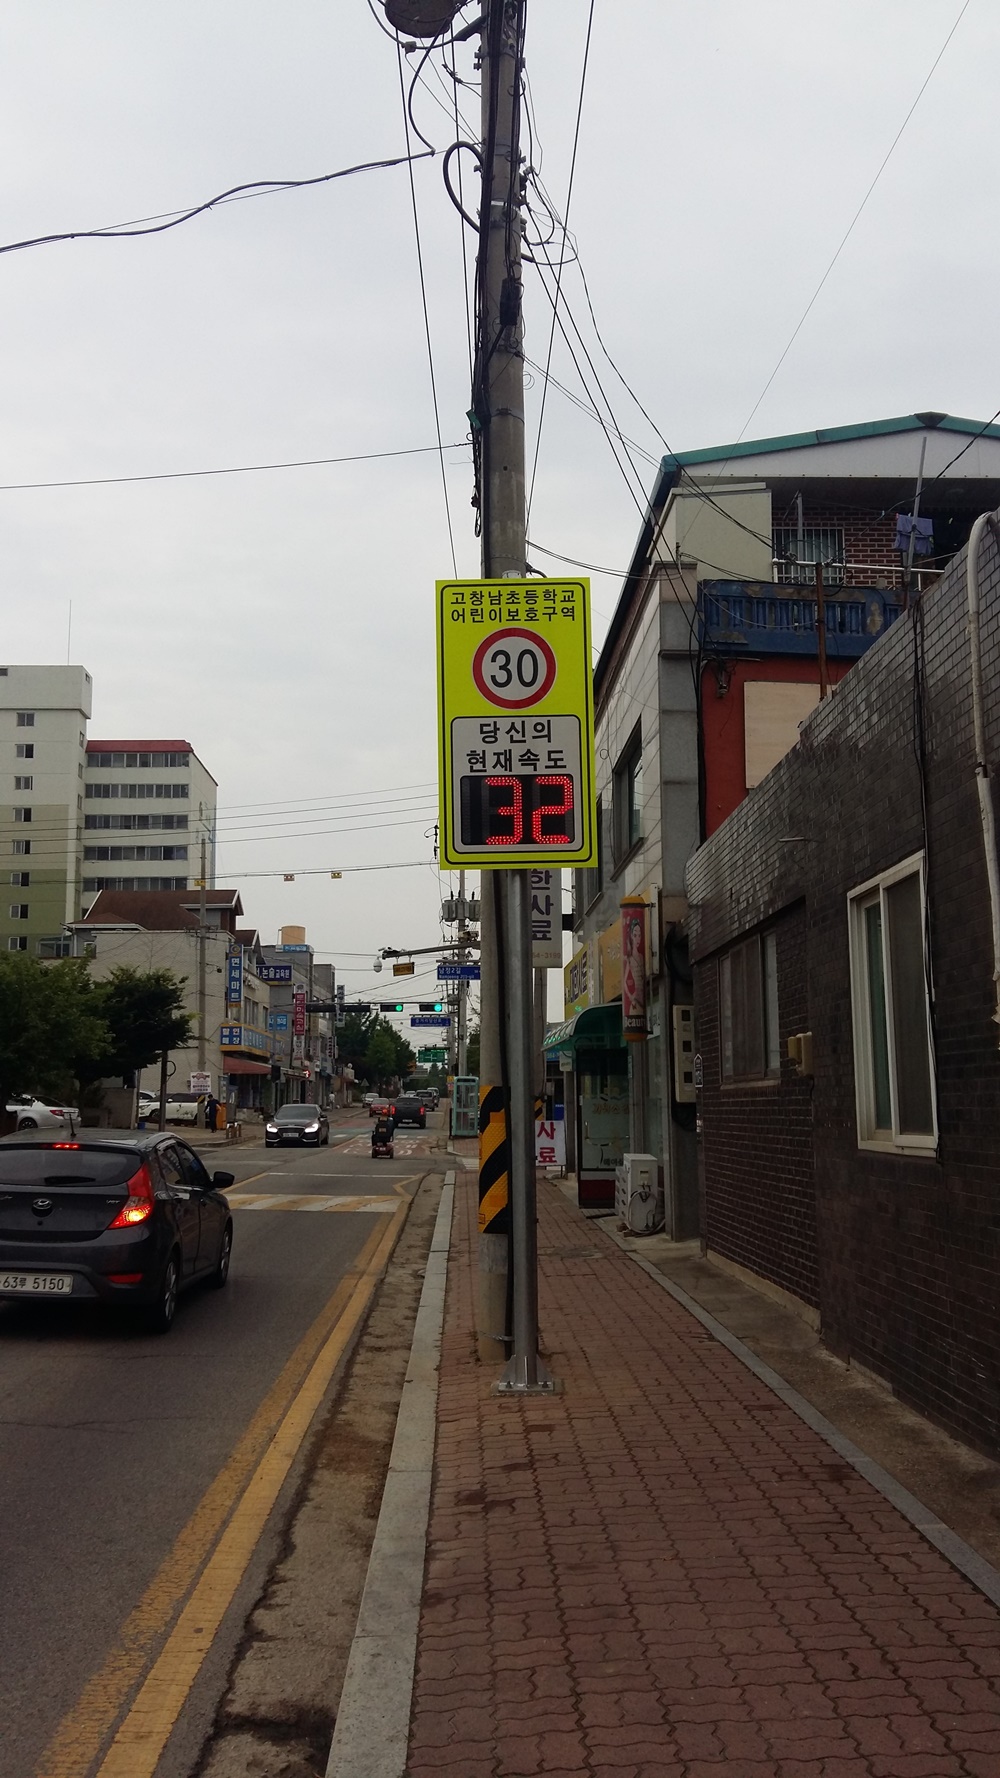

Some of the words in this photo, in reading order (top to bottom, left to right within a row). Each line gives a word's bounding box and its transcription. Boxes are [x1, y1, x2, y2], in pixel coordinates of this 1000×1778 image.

[450, 588, 576, 606] 고창남초등학교
[450, 606, 576, 623] 어린이보호구역
[490, 649, 539, 688] 30
[479, 720, 552, 744] 당신의
[466, 748, 567, 773] 현재속도
[485, 776, 573, 845] 32
[537, 1121, 557, 1164] 사료
[32, 1278, 65, 1290] 5150
